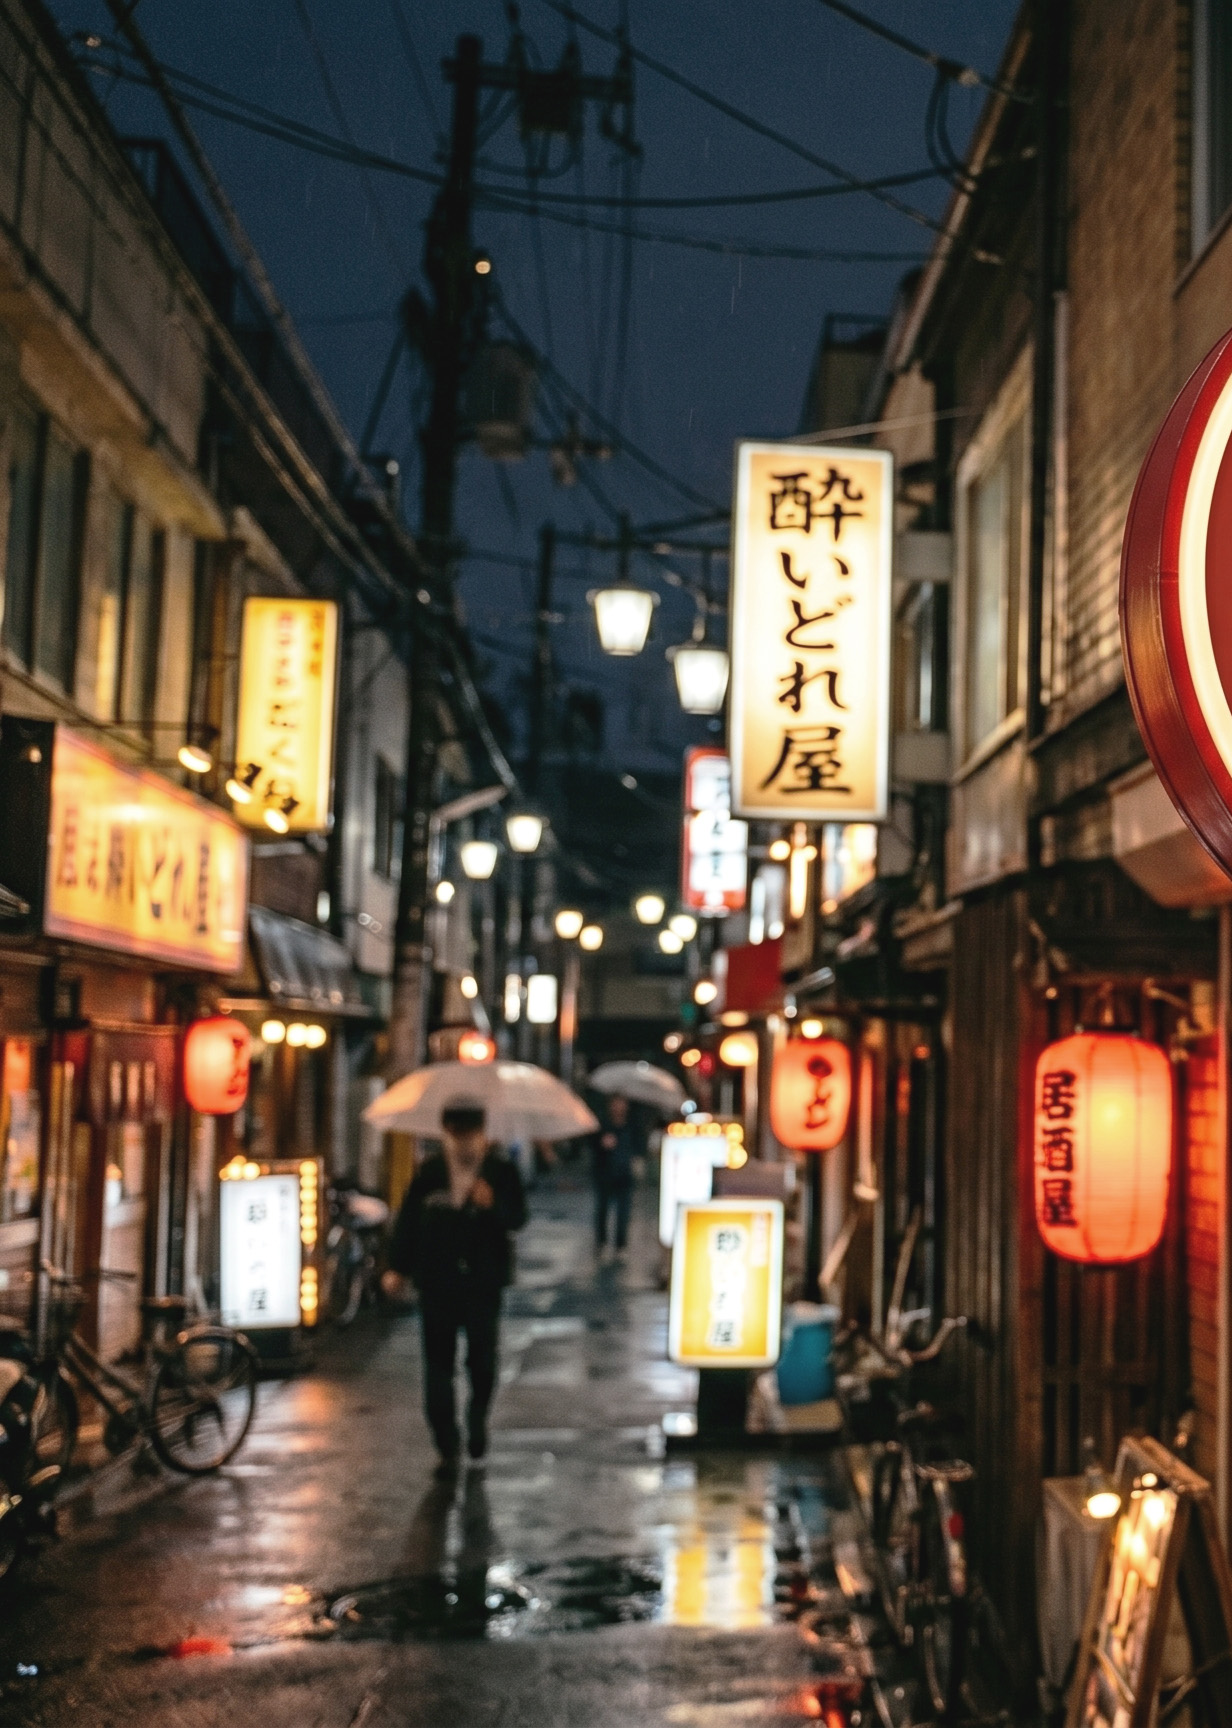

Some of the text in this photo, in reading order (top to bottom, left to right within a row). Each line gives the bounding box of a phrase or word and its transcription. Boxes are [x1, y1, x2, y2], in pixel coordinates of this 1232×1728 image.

[761, 468, 864, 794] 酔いどれ屋
[1042, 1070, 1078, 1228] 居酒屋
